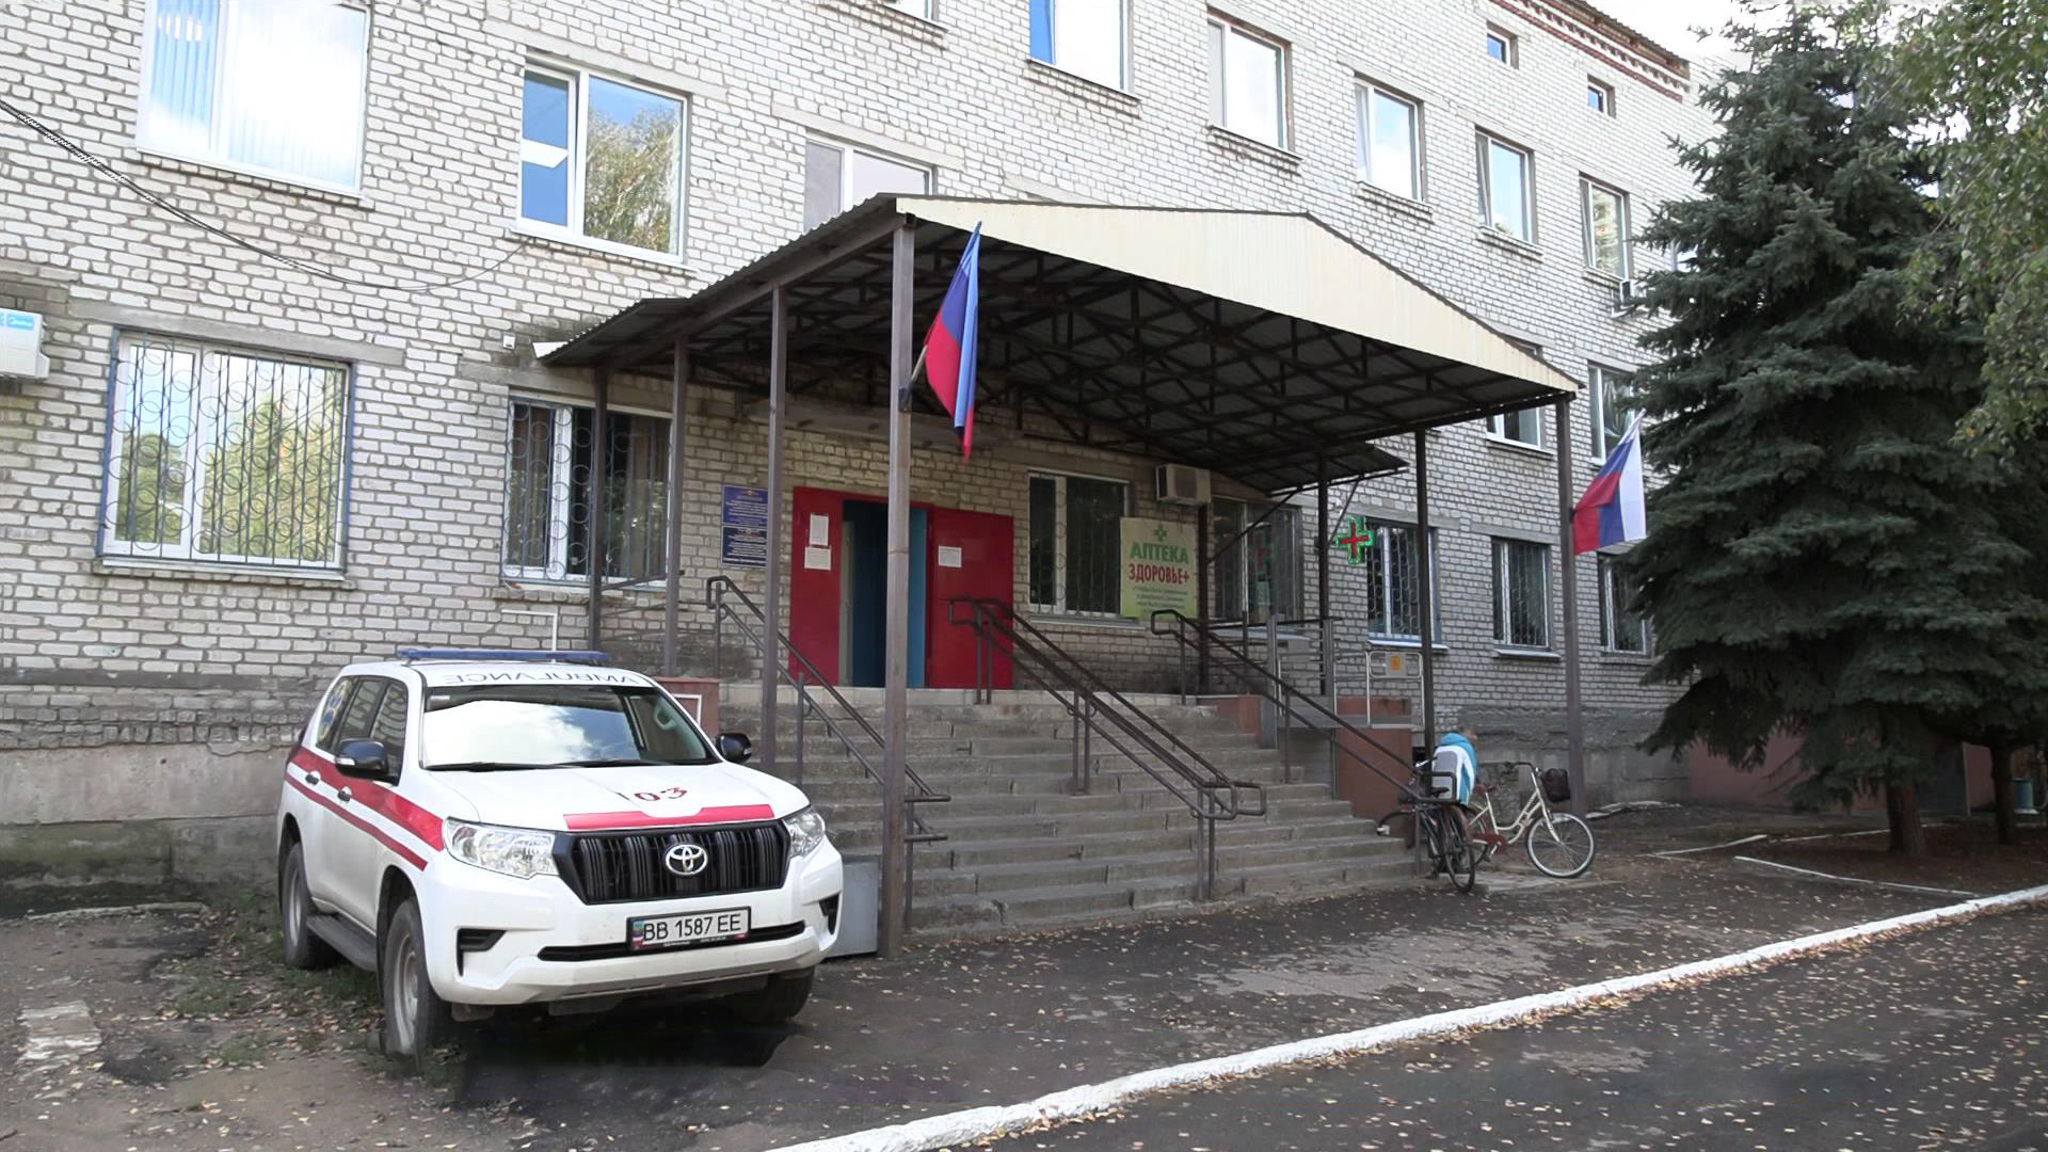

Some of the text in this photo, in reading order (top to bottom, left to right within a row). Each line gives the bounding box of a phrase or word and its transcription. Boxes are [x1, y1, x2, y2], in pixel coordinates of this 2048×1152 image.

[1129, 542, 1189, 564] АПТЕКА
[1129, 563, 1190, 585] ЗДОРОВЬЕ+
[674, 916, 714, 938] 1587
